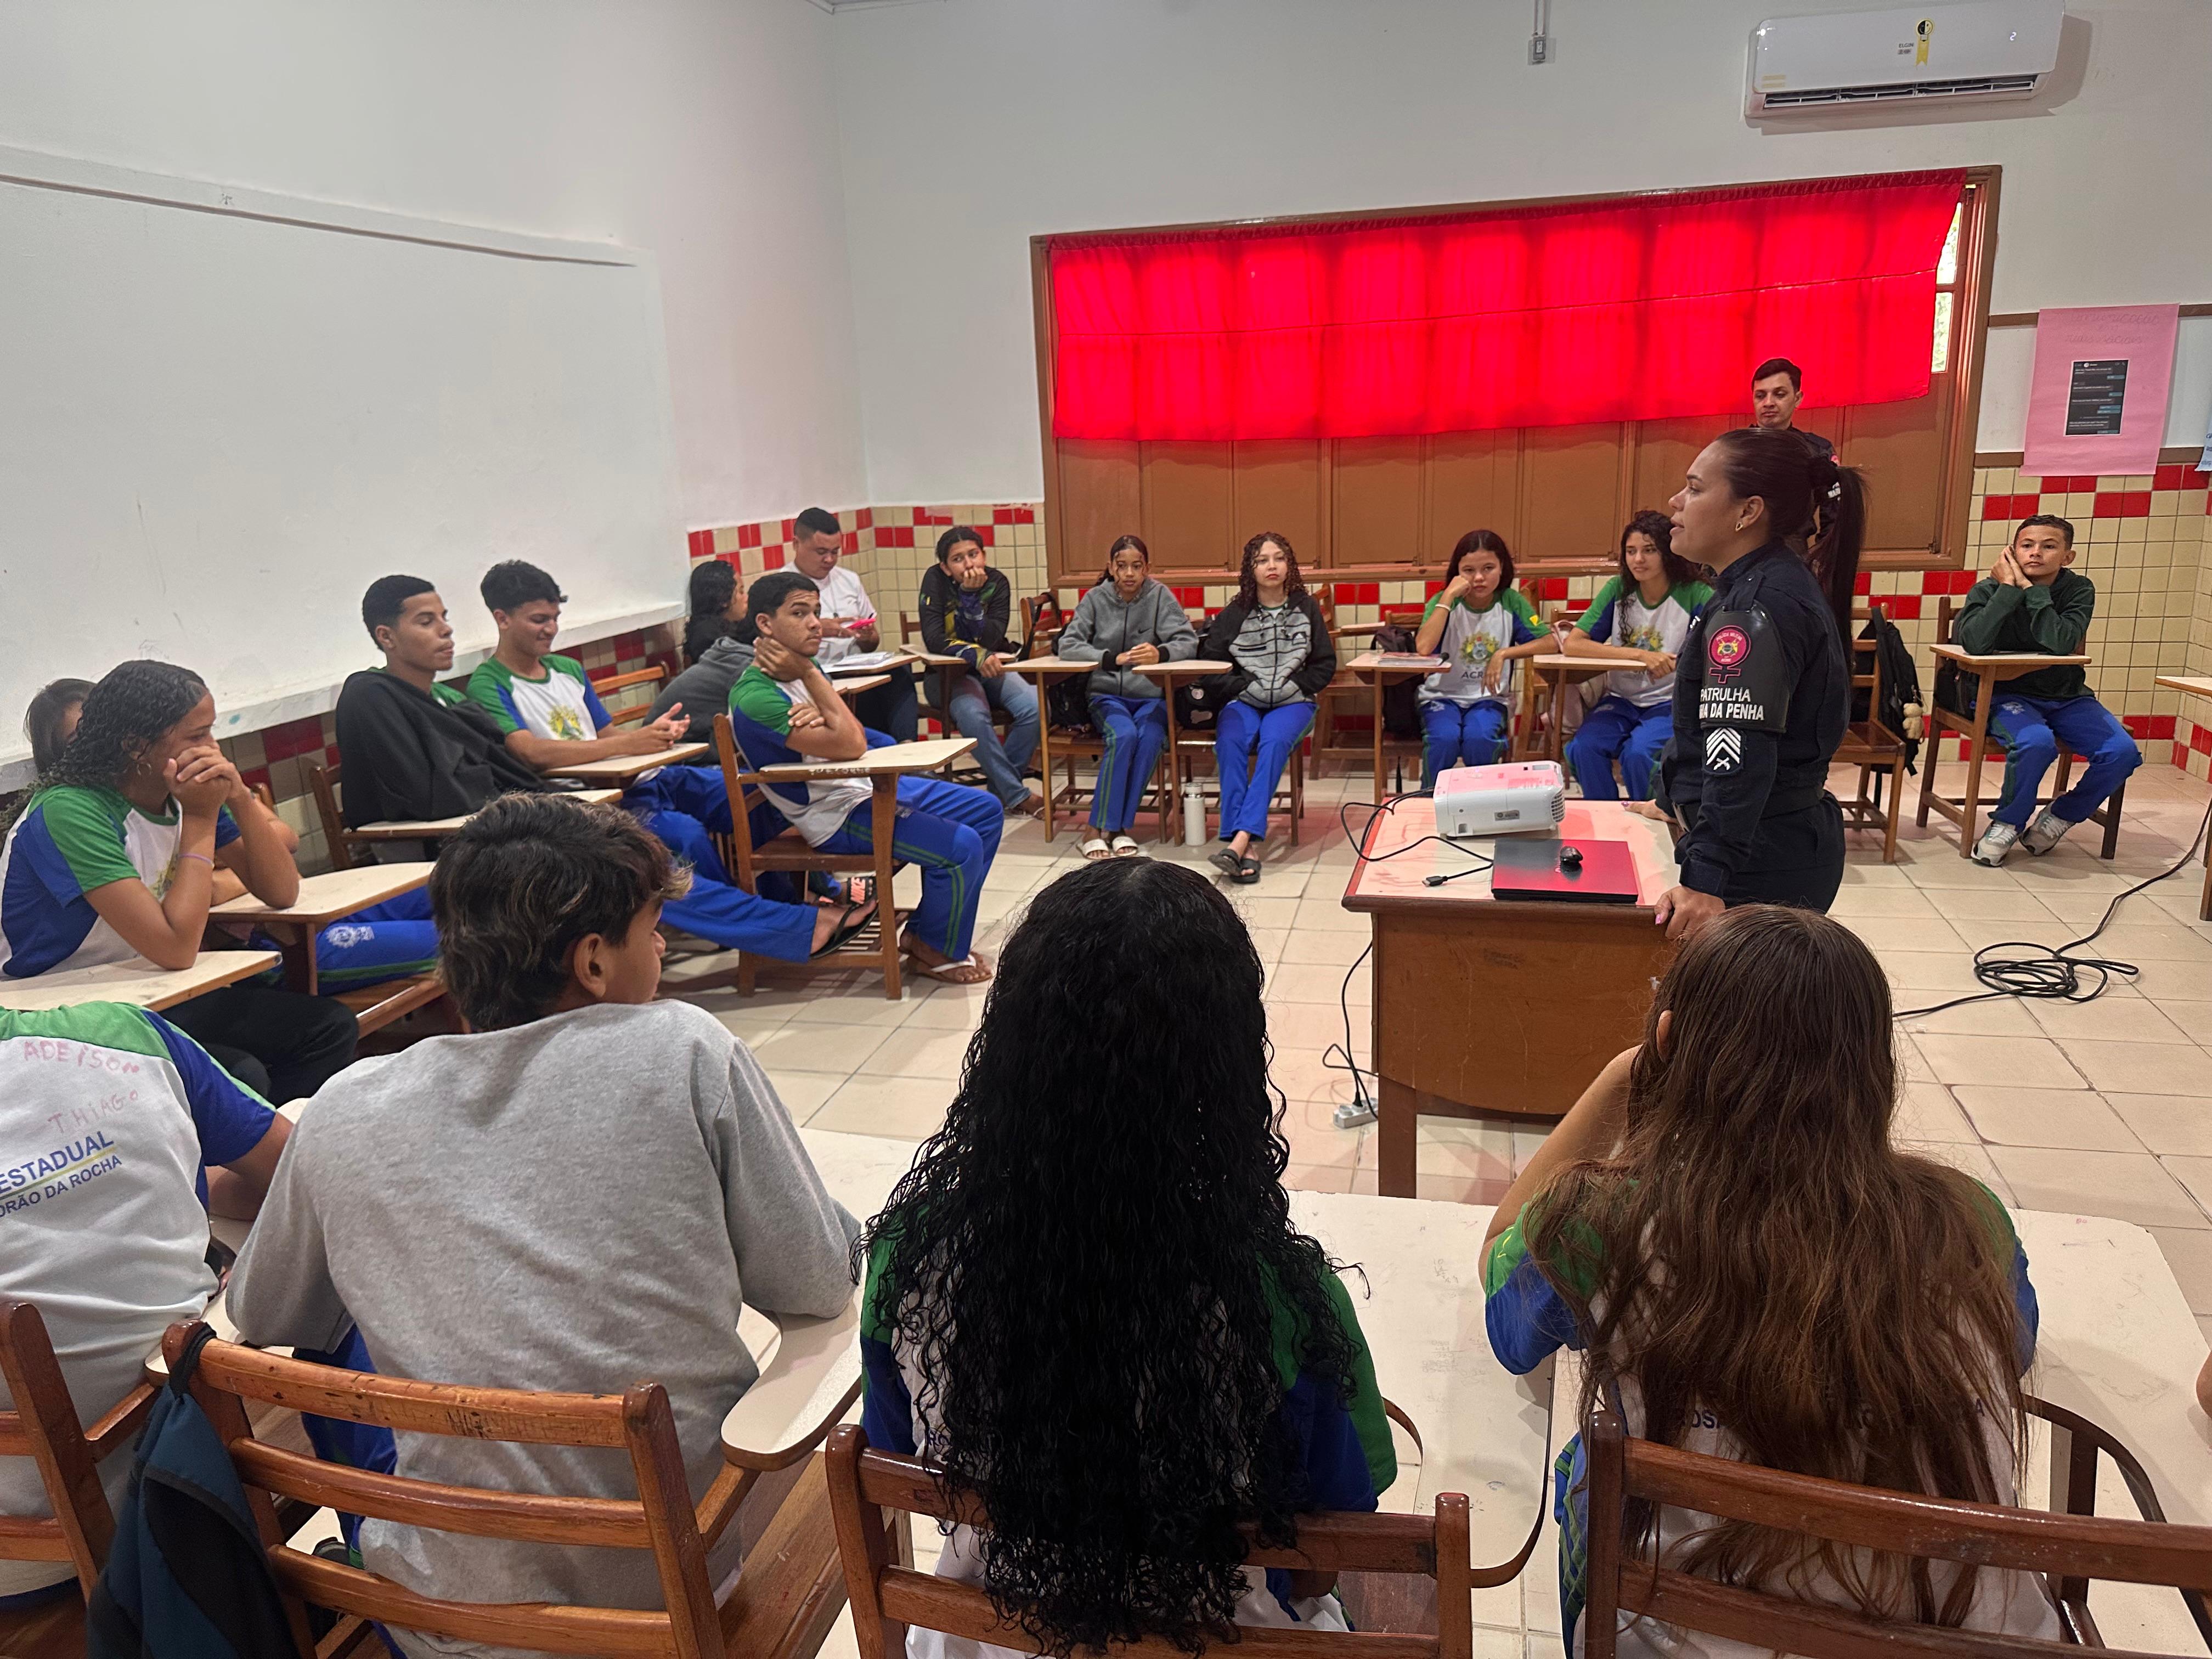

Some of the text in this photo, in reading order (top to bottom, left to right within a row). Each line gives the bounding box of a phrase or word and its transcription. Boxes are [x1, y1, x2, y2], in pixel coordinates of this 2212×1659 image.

[1700, 687, 1751, 702] PATRULHA
[1709, 703, 1723, 718] DA
[1725, 703, 1764, 720] PENHA
[0, 1131, 114, 1194] ESTADUAL
[44, 1181, 69, 1199] DA
[69, 1155, 122, 1188] ROCHA
